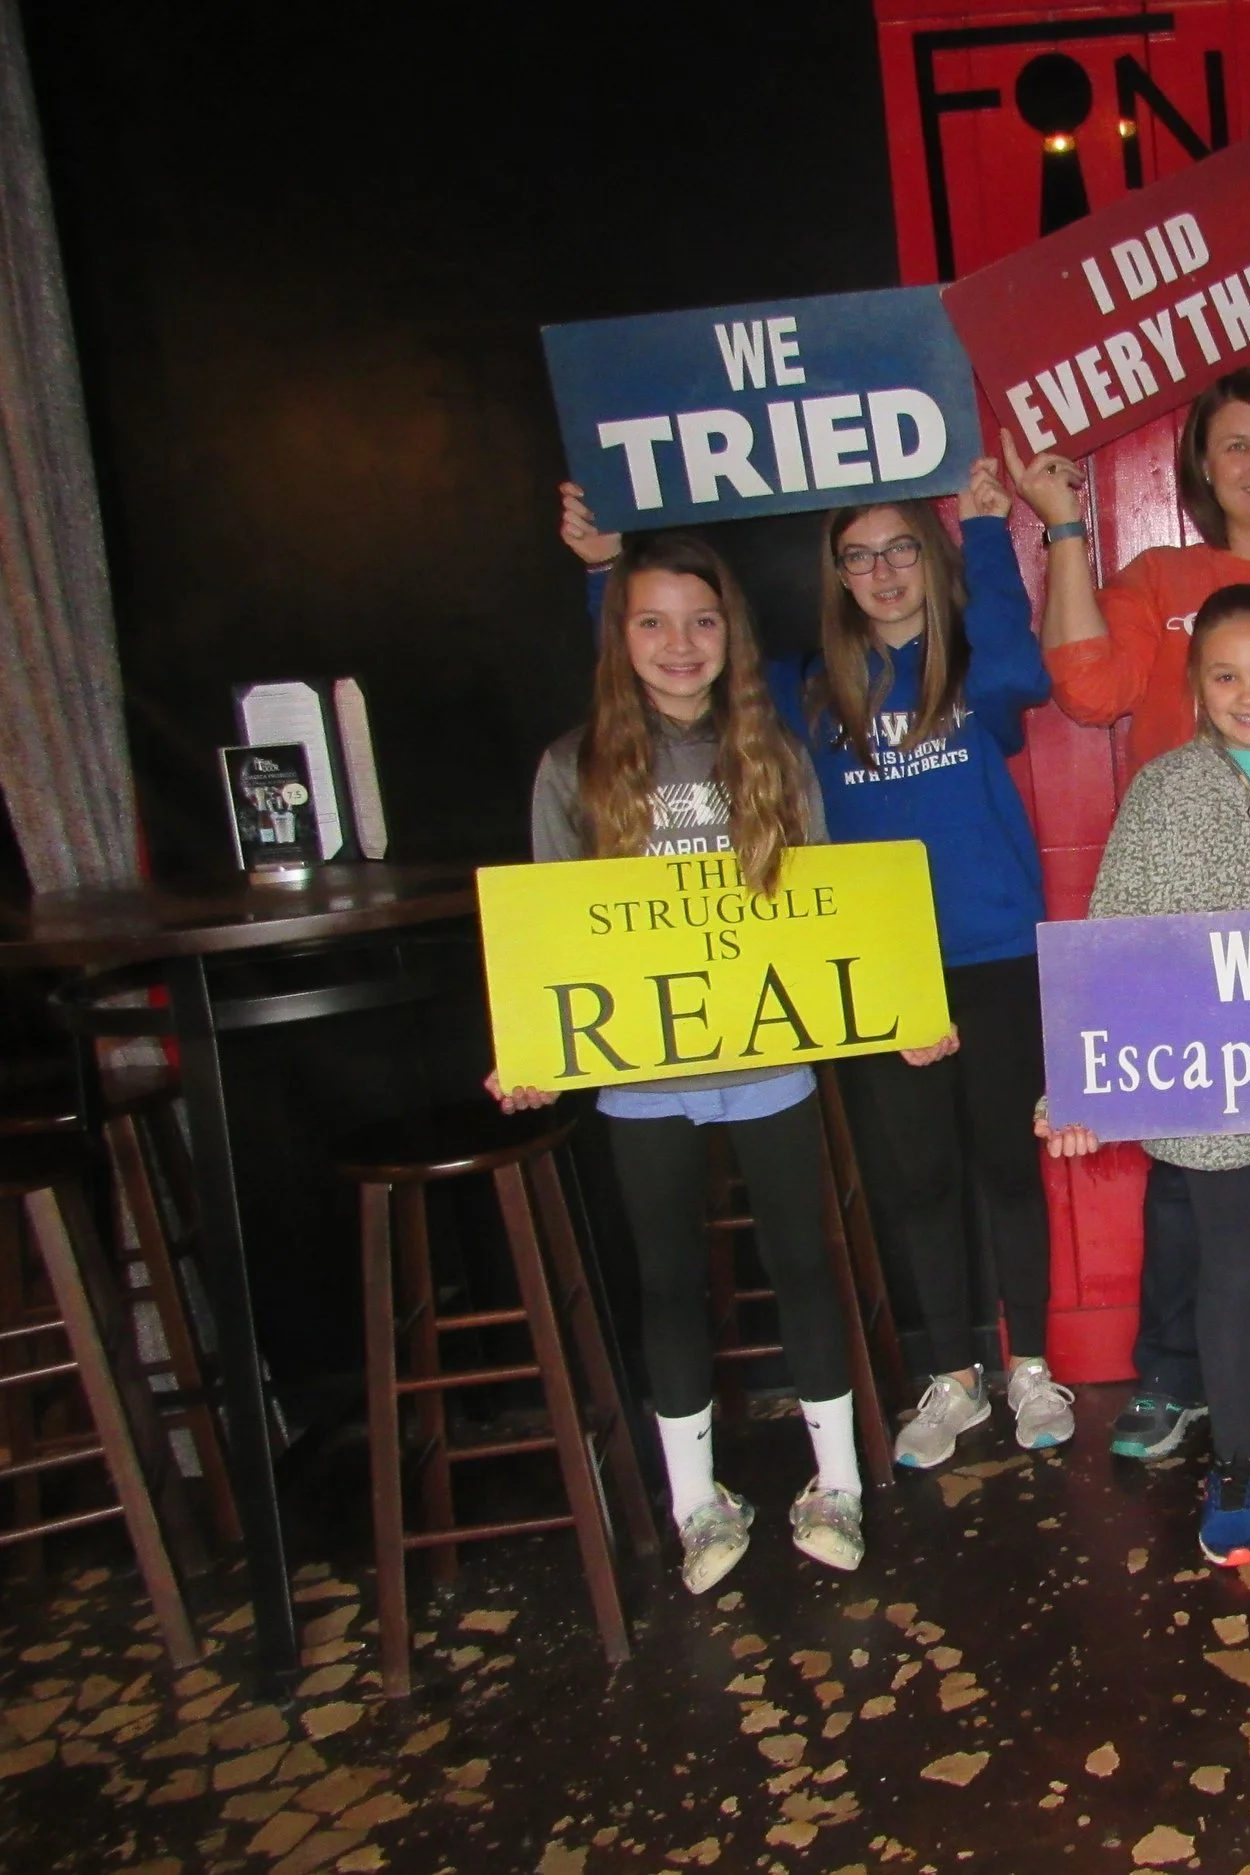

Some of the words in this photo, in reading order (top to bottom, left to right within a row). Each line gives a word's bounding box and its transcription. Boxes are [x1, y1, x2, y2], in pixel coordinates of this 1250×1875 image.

[1081, 256, 1115, 316] I
[1111, 212, 1210, 301] DID
[714, 316, 806, 392] WE
[597, 388, 947, 511] TRIED
[844, 768, 865, 786] MY
[921, 748, 969, 773] BEATS
[588, 886, 838, 935] STRUGGLE
[702, 929, 742, 962] IS
[543, 956, 900, 1079] REAL
